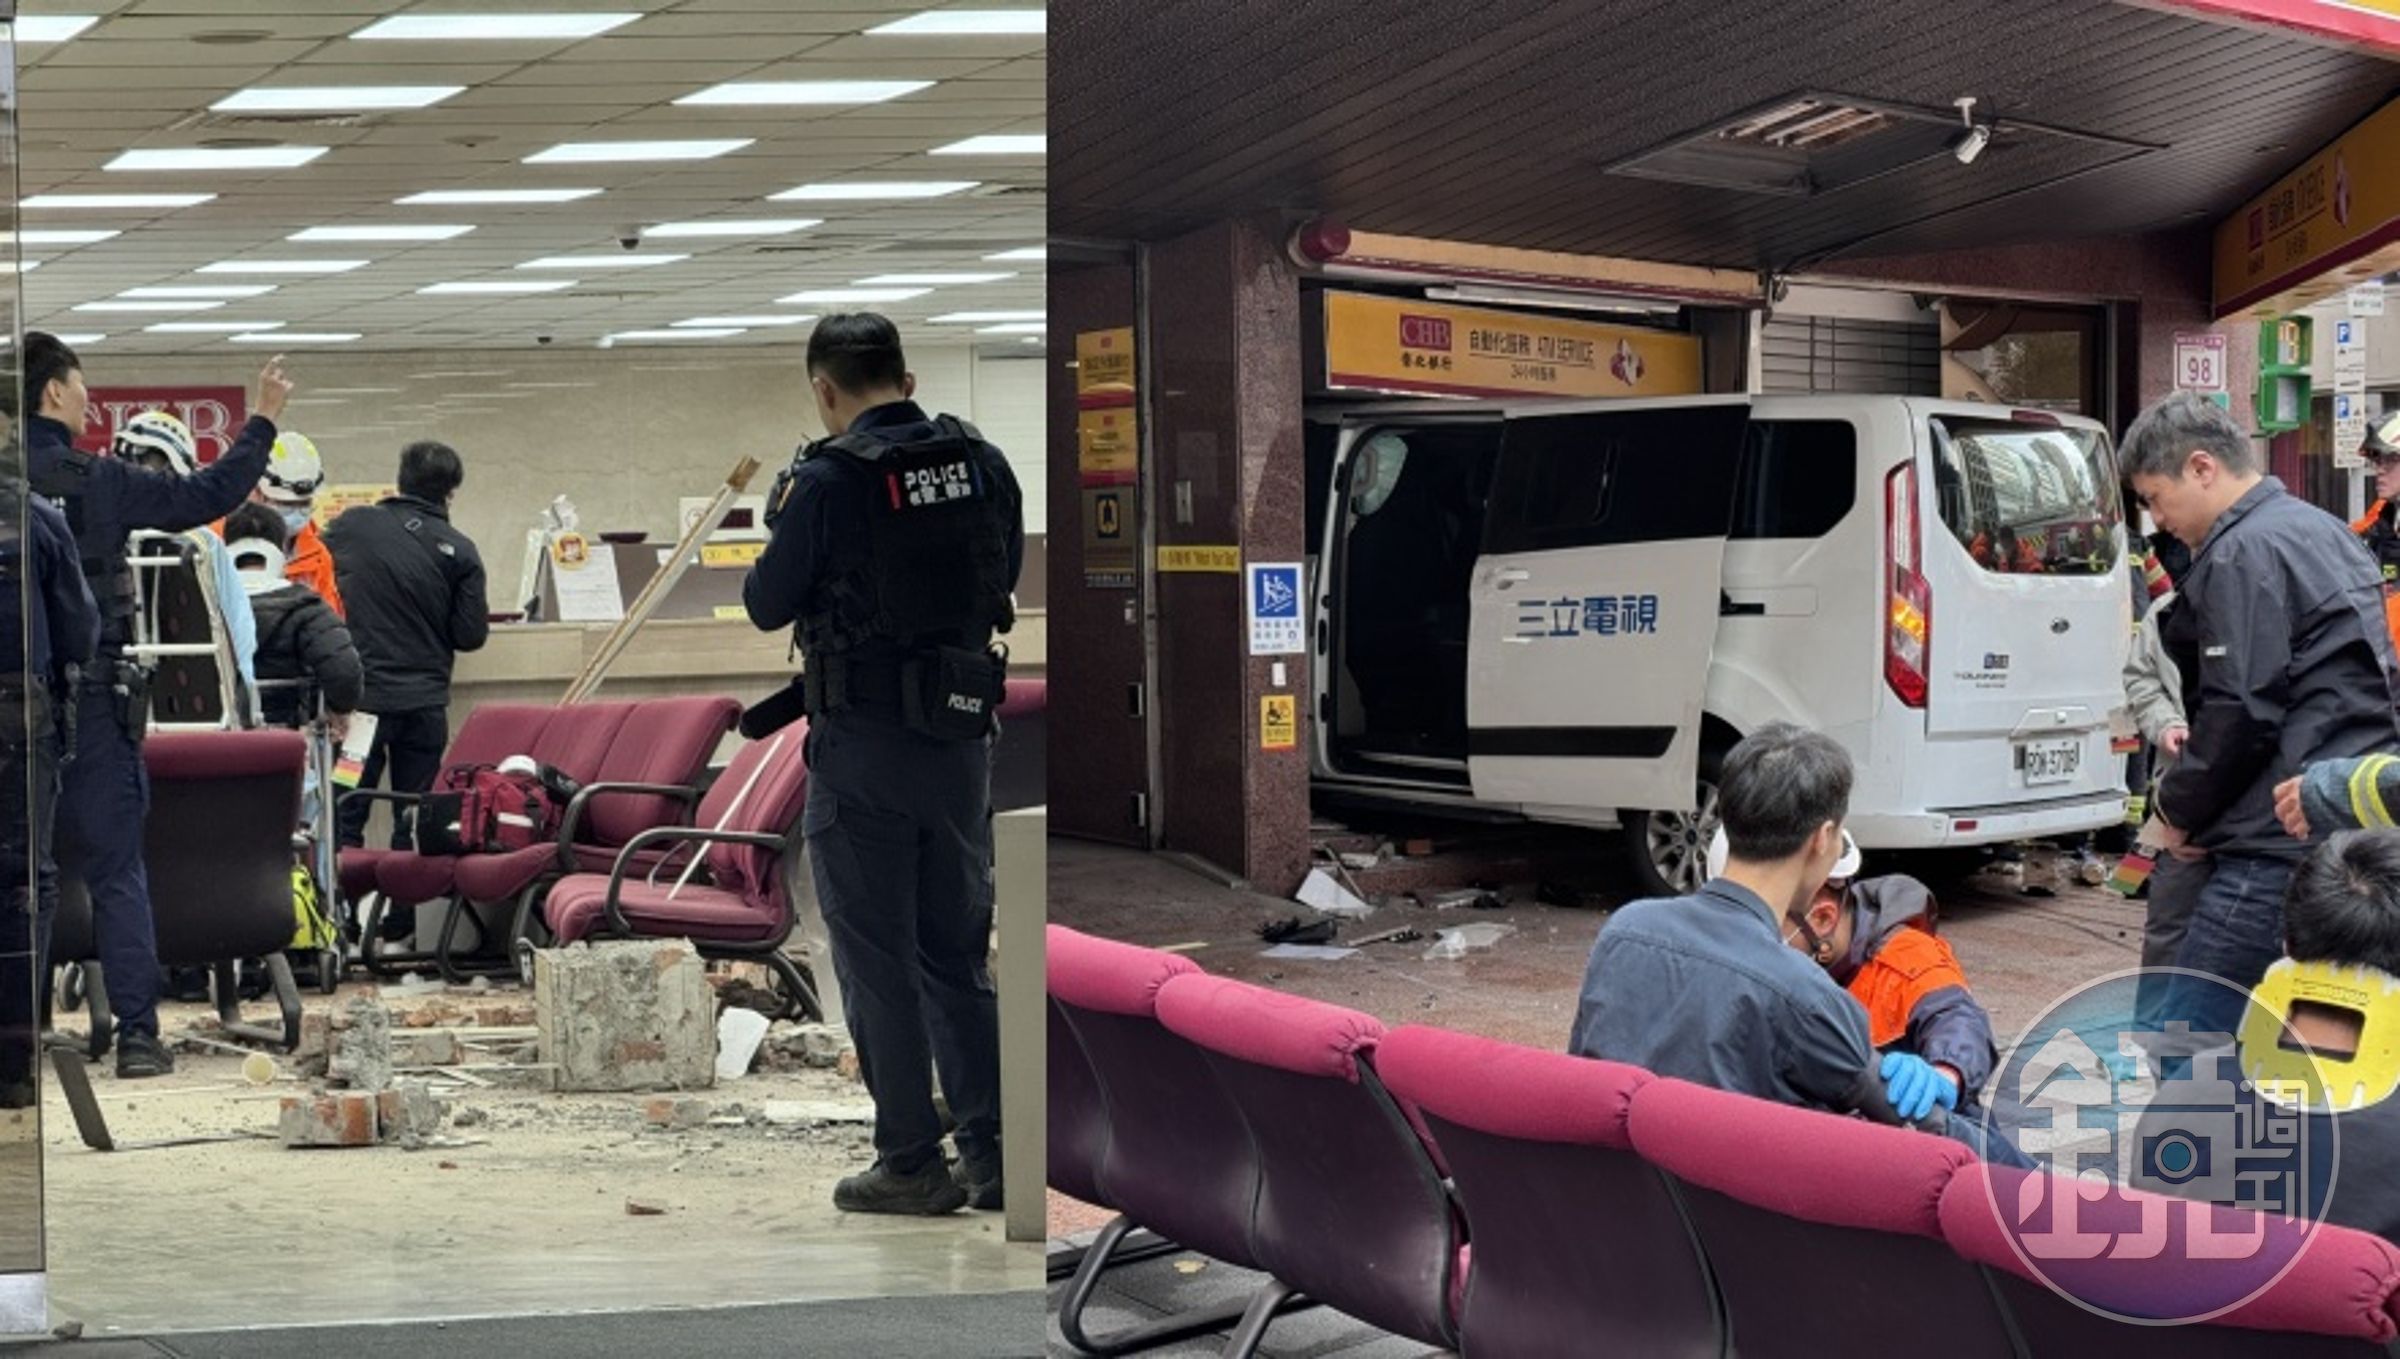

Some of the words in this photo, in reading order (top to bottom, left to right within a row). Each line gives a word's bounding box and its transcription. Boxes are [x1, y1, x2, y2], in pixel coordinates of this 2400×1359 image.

[1401, 317, 1450, 348] CHB
[2187, 356, 2213, 384] 98
[904, 461, 969, 491] POLICE
[1515, 595, 1658, 637] 三立電視
[947, 692, 983, 714] POLICE
